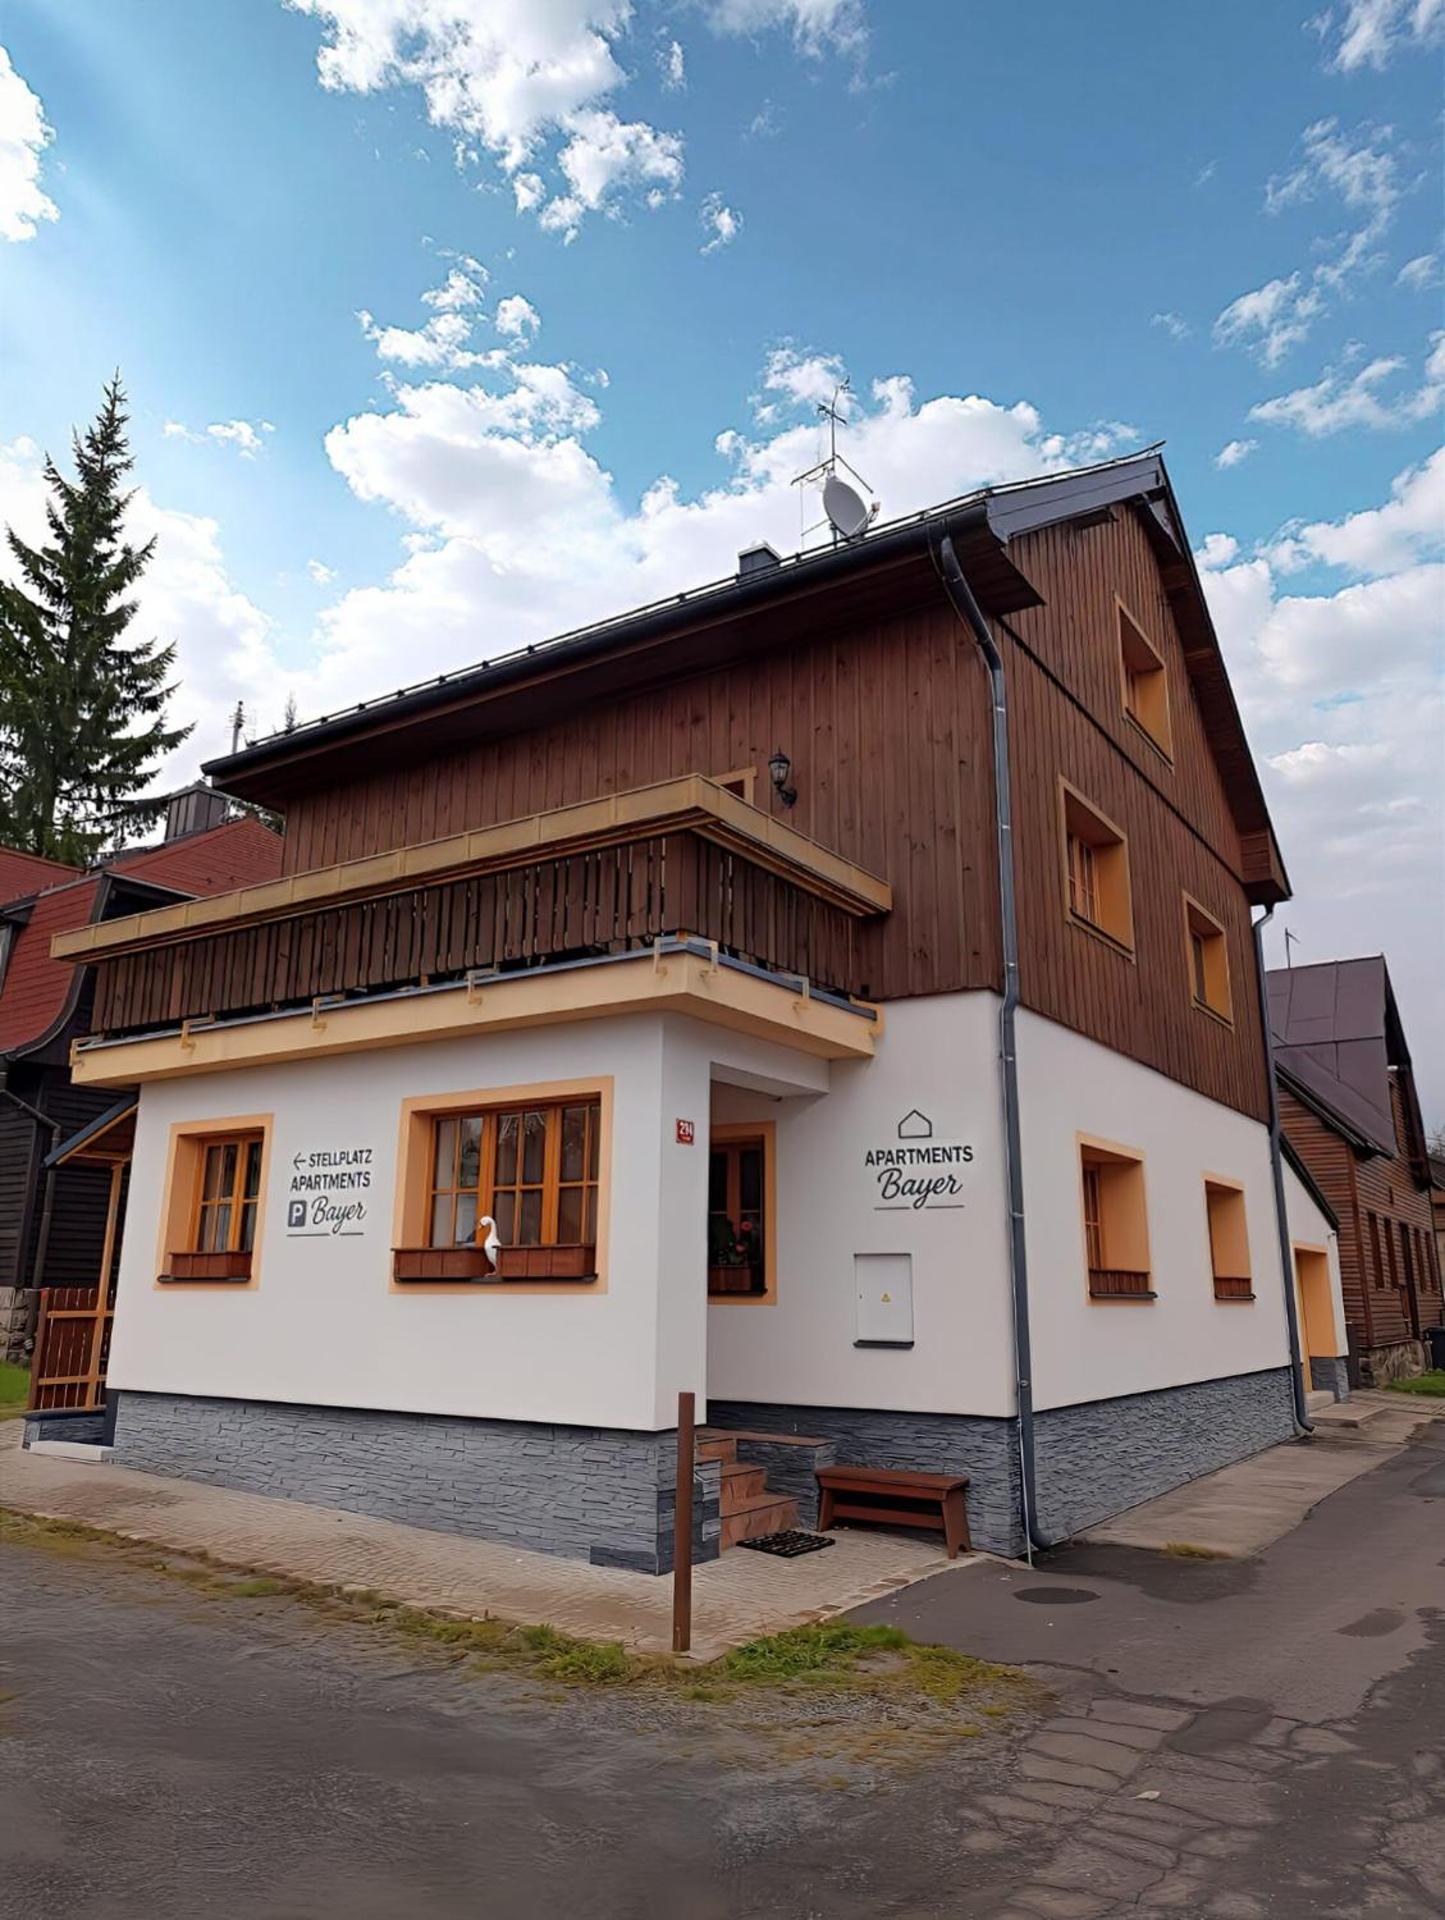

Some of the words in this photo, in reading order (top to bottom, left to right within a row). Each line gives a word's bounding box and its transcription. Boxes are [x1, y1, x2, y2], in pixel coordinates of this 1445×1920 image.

[308, 1149, 372, 1168] STELLPLATZ
[865, 1145, 974, 1166] APARTMENTS
[290, 1171, 371, 1192] APARTMENTS
[877, 1167, 963, 1210] Bayer
[291, 1202, 304, 1226] P
[311, 1195, 367, 1234] Bayer
